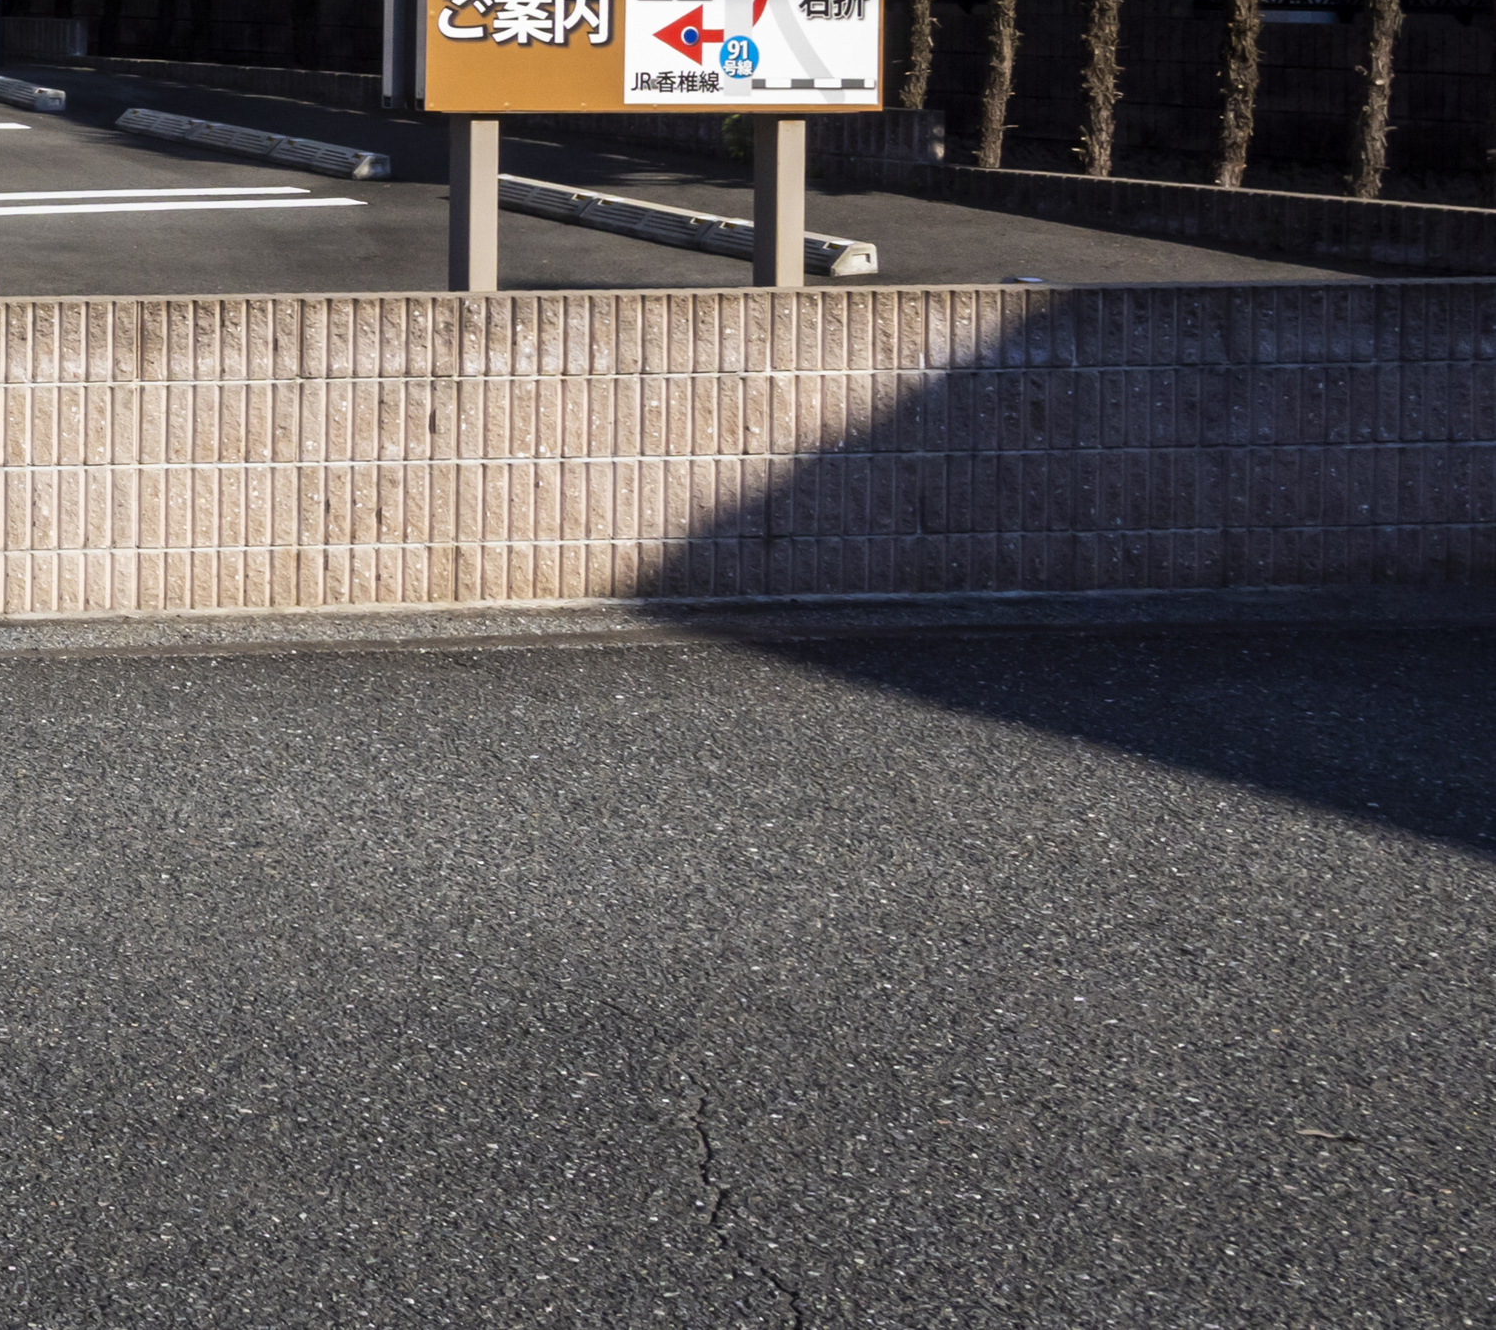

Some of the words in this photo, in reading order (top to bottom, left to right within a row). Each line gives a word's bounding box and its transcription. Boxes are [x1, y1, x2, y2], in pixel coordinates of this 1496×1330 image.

[726, 41, 749, 60] 91
[723, 60, 753, 77] 号線
[631, 72, 652, 91] JR
[656, 71, 720, 93] 香椎線
